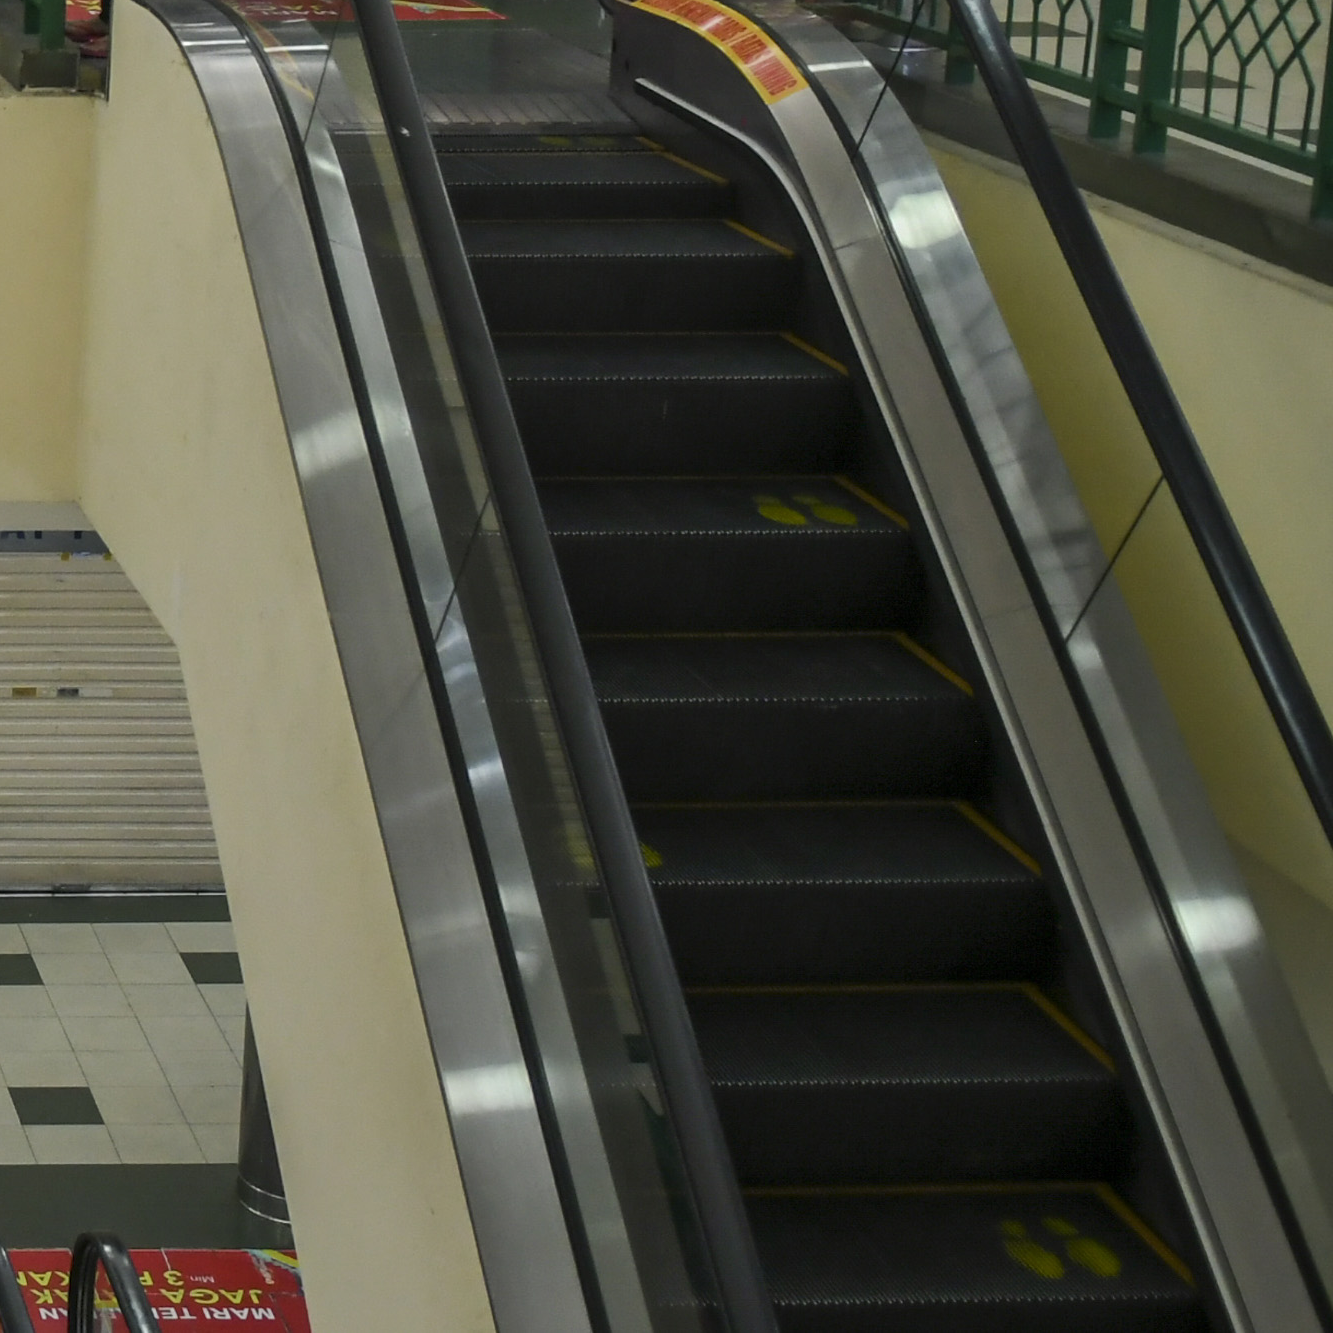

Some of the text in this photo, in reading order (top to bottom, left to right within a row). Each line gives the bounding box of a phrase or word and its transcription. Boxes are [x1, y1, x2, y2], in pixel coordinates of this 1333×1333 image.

[163, 1270, 185, 1286] 3
[160, 1288, 264, 1305] JAGA
[204, 1307, 276, 1321] MARI
